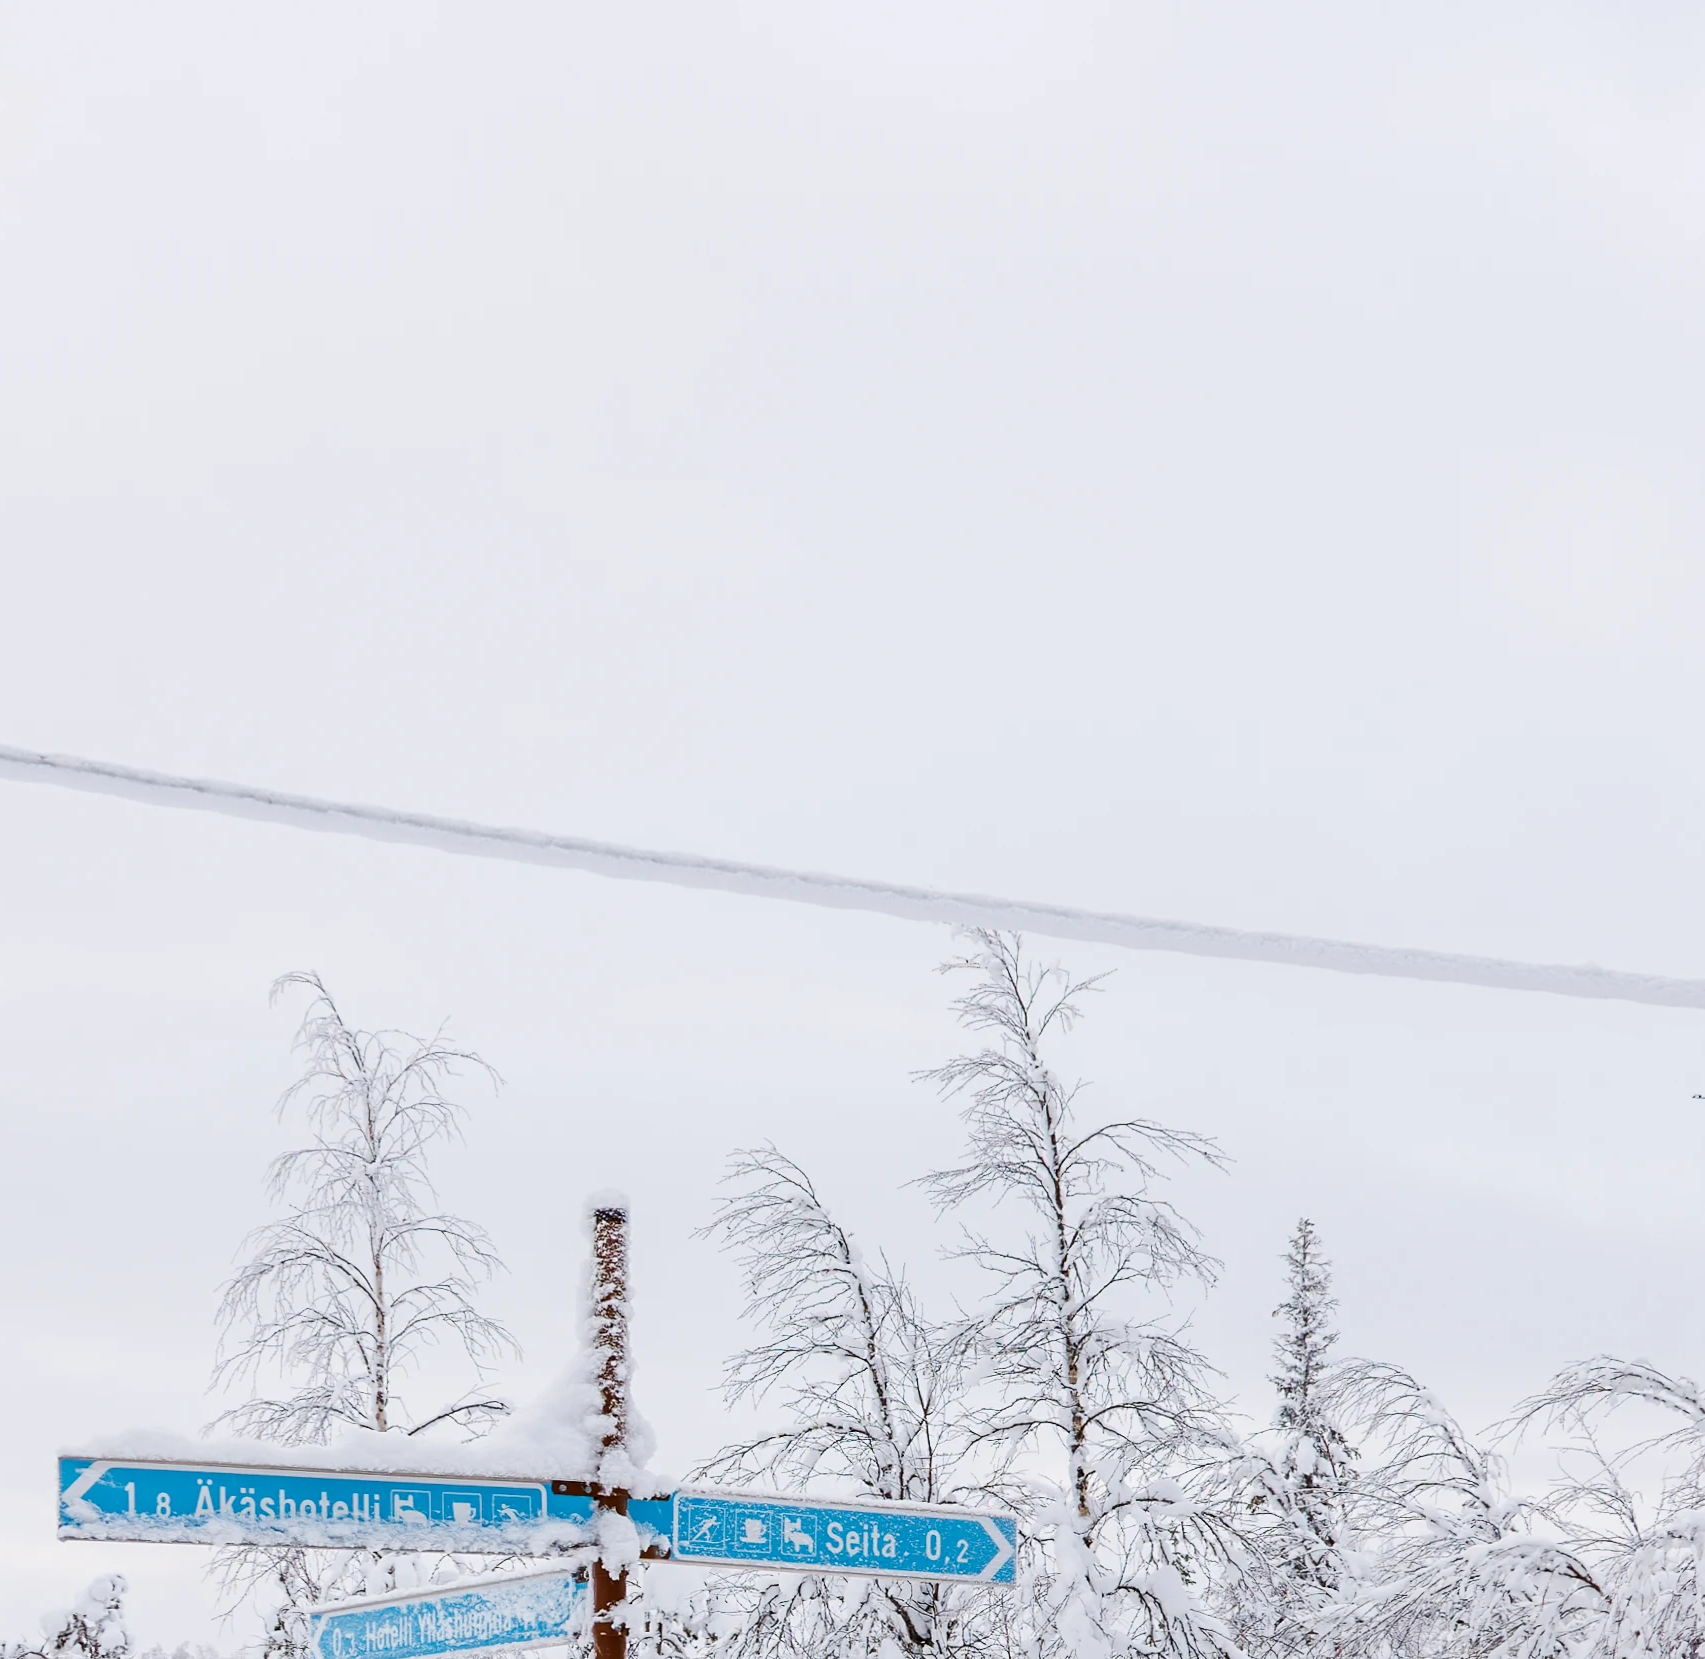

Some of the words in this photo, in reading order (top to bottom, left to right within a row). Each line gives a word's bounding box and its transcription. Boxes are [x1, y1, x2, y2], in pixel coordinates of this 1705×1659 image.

[195, 1478, 381, 1523] Äkäshotelli
[825, 1521, 897, 1559] Seita
[925, 1529, 970, 1564] 0,2
[364, 1615, 413, 1652] Hotelli
